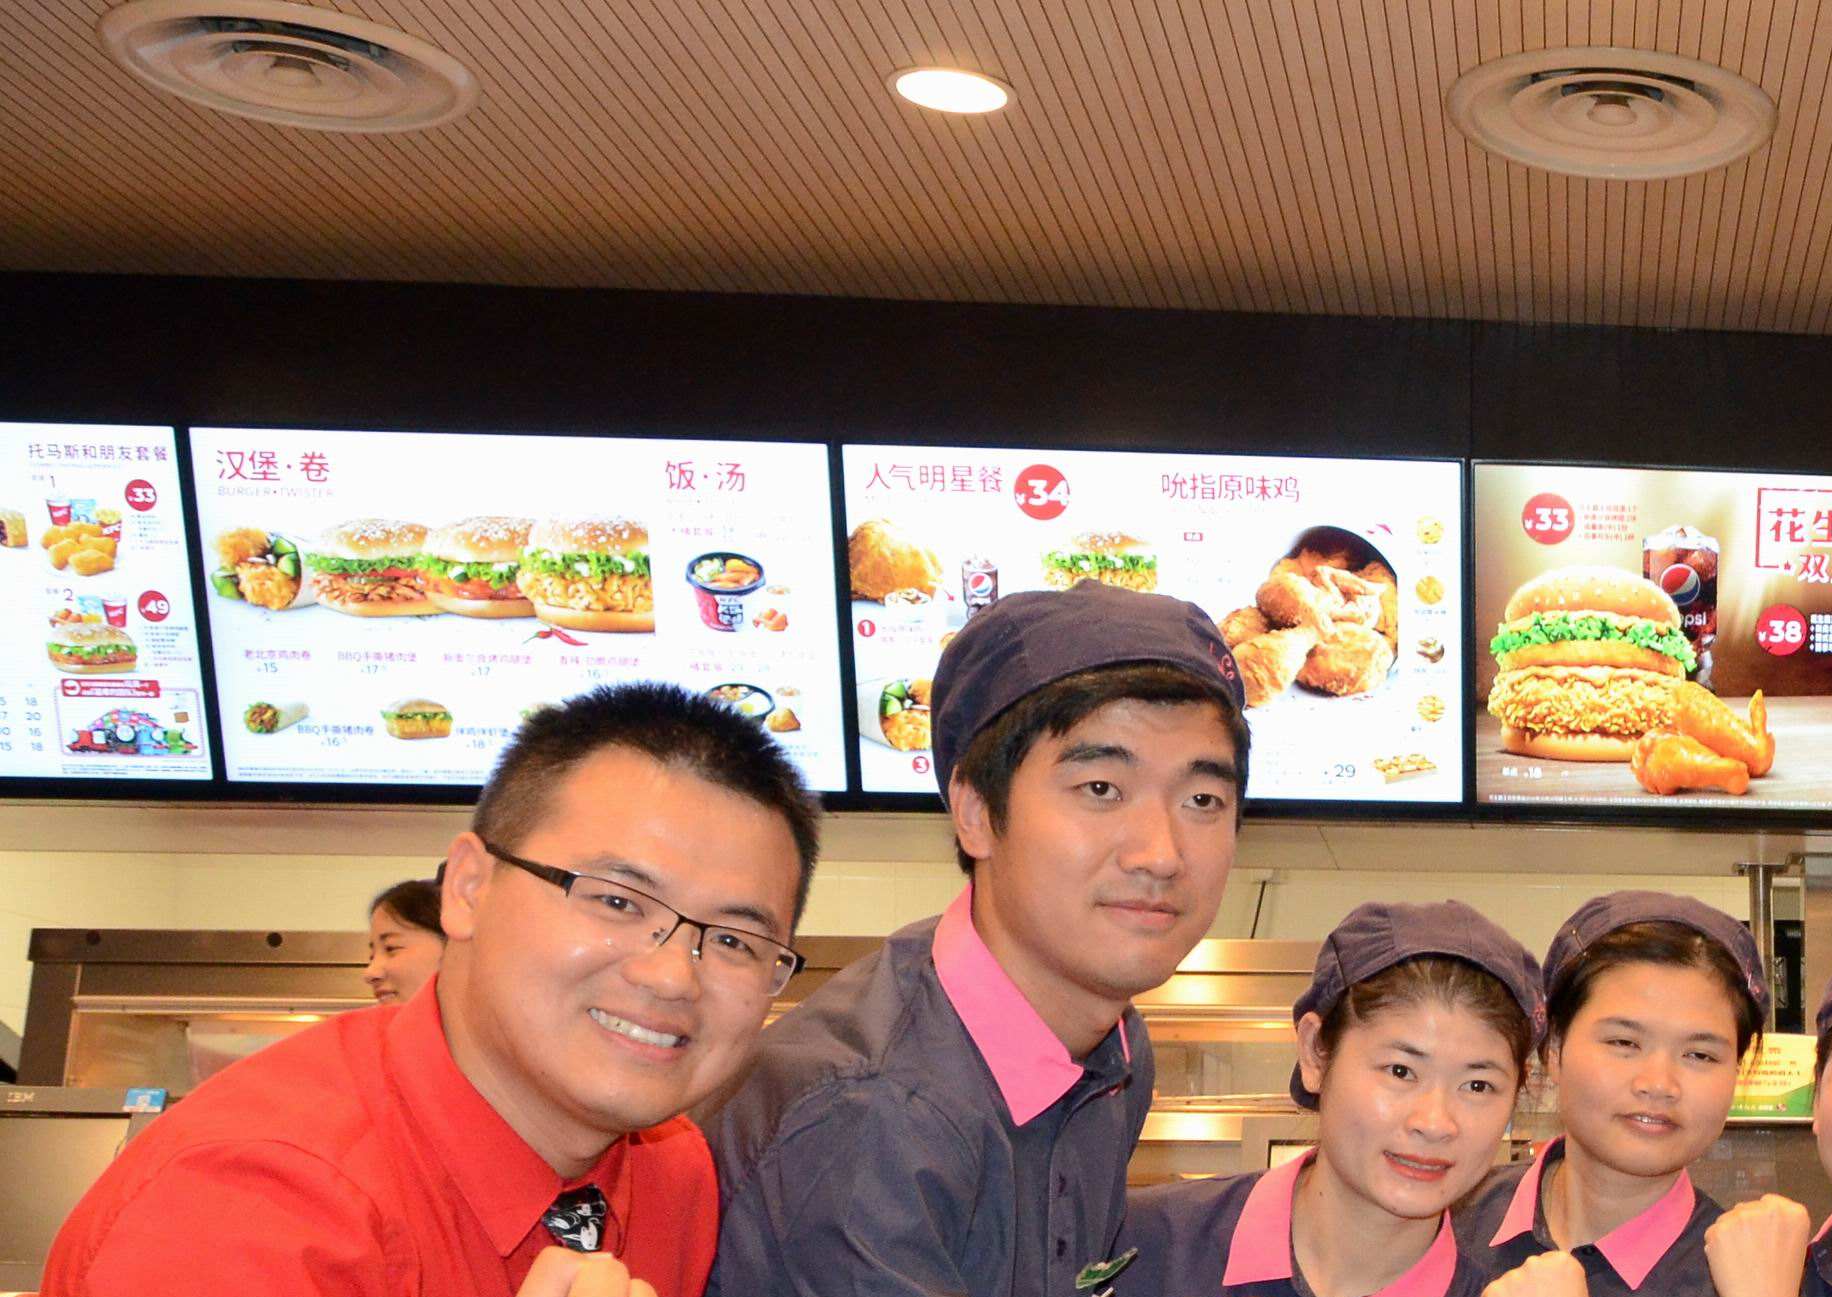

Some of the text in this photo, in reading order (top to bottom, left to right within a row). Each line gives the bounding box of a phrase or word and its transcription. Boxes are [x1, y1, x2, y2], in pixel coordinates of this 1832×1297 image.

[866, 463, 1003, 493] 人气明星餐
[1161, 472, 1301, 503] 吮指原味鸡
